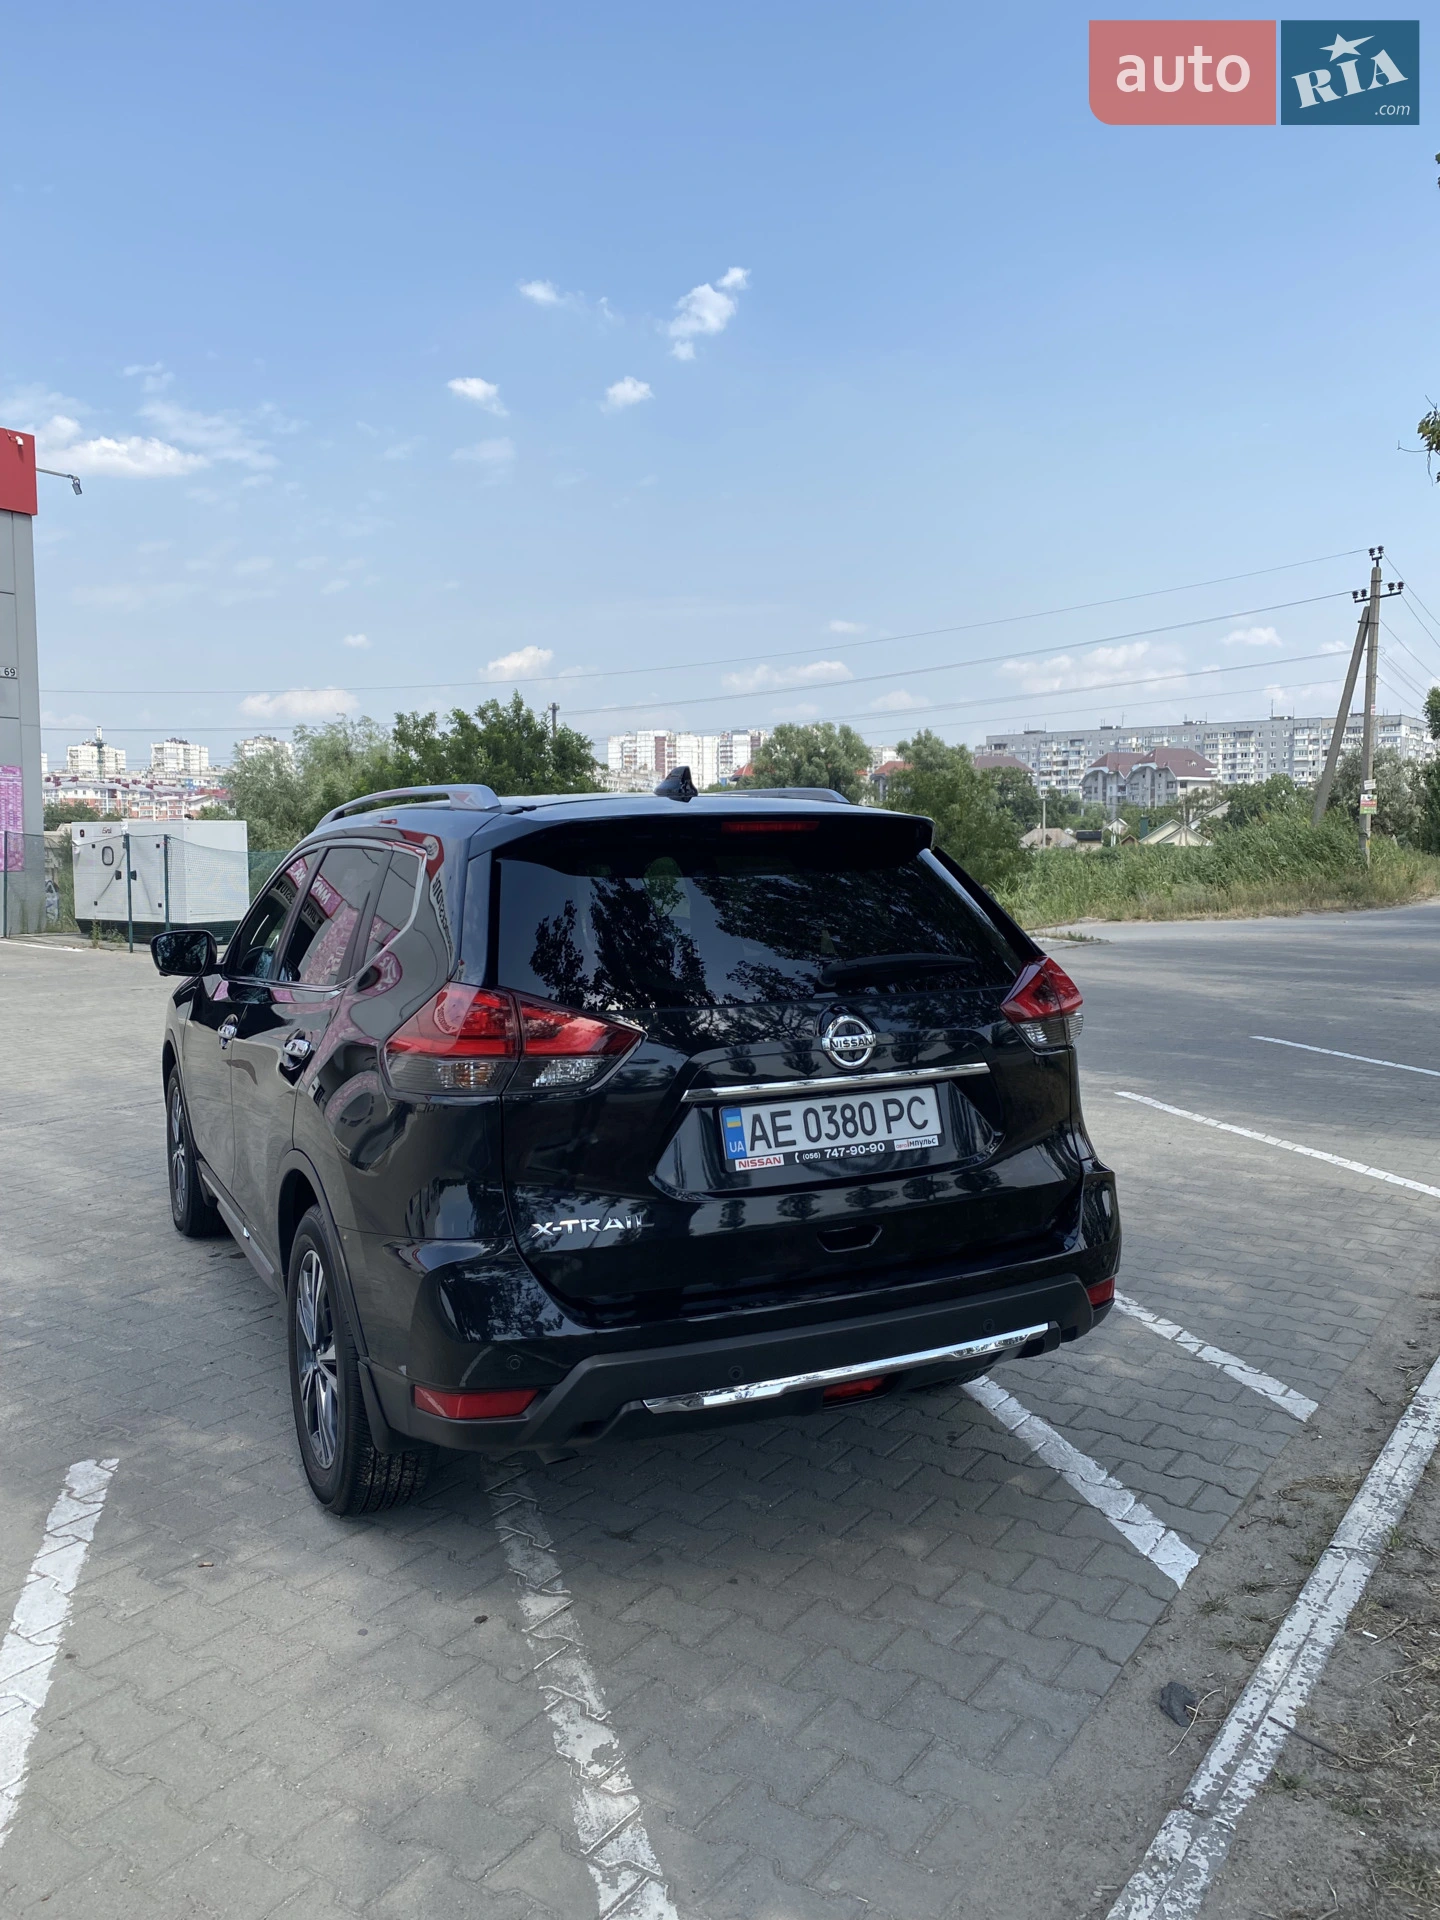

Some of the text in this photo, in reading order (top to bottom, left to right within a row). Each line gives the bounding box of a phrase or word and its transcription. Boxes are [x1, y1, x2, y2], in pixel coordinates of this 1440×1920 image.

[4, 667, 16, 677] 69
[829, 1036, 874, 1050] NISSAN
[750, 1096, 928, 1152] AE 0380 PC
[729, 1141, 745, 1153] UA
[803, 1142, 885, 1161] (056) 747-90-90
[738, 1156, 782, 1169] NISSAN
[531, 1214, 655, 1239] X-TRAIL
